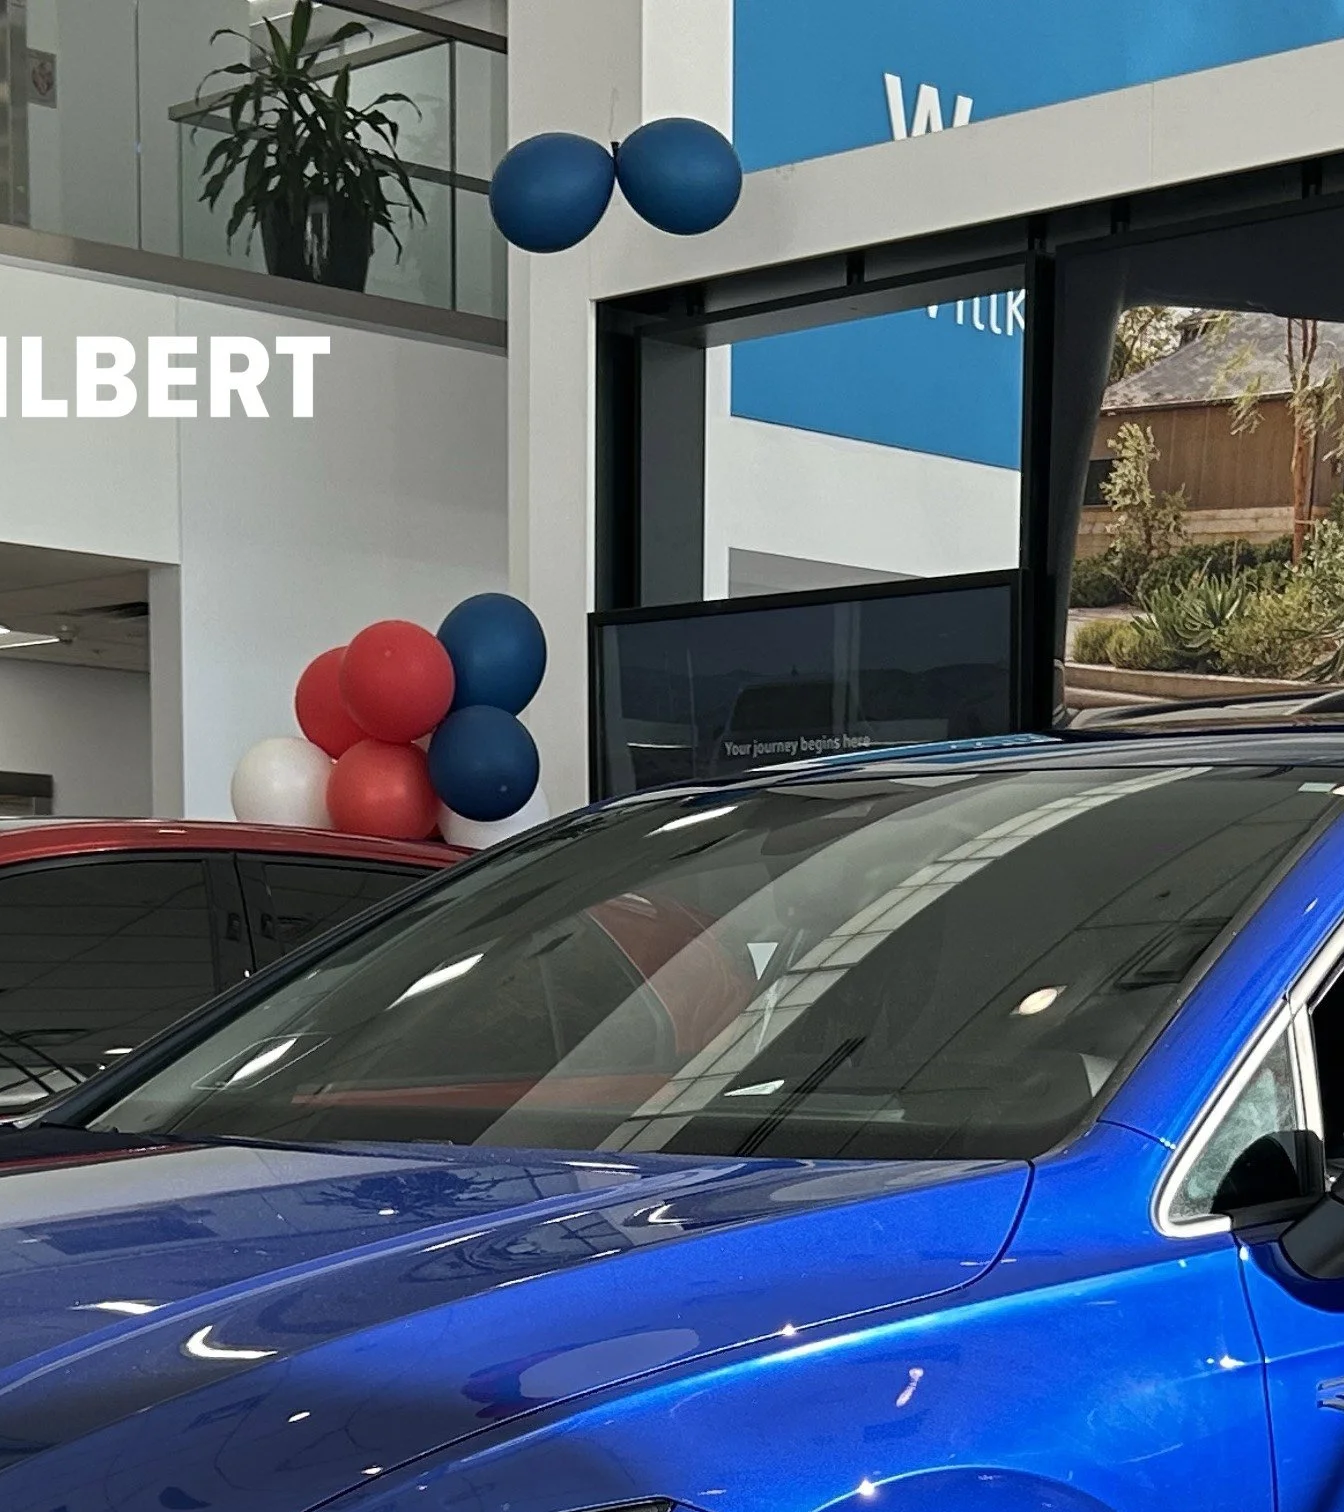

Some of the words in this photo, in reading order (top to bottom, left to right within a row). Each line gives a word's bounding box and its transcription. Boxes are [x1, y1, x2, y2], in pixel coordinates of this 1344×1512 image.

[724, 741, 751, 756] Your
[753, 739, 798, 758] journey
[800, 735, 841, 754] begins
